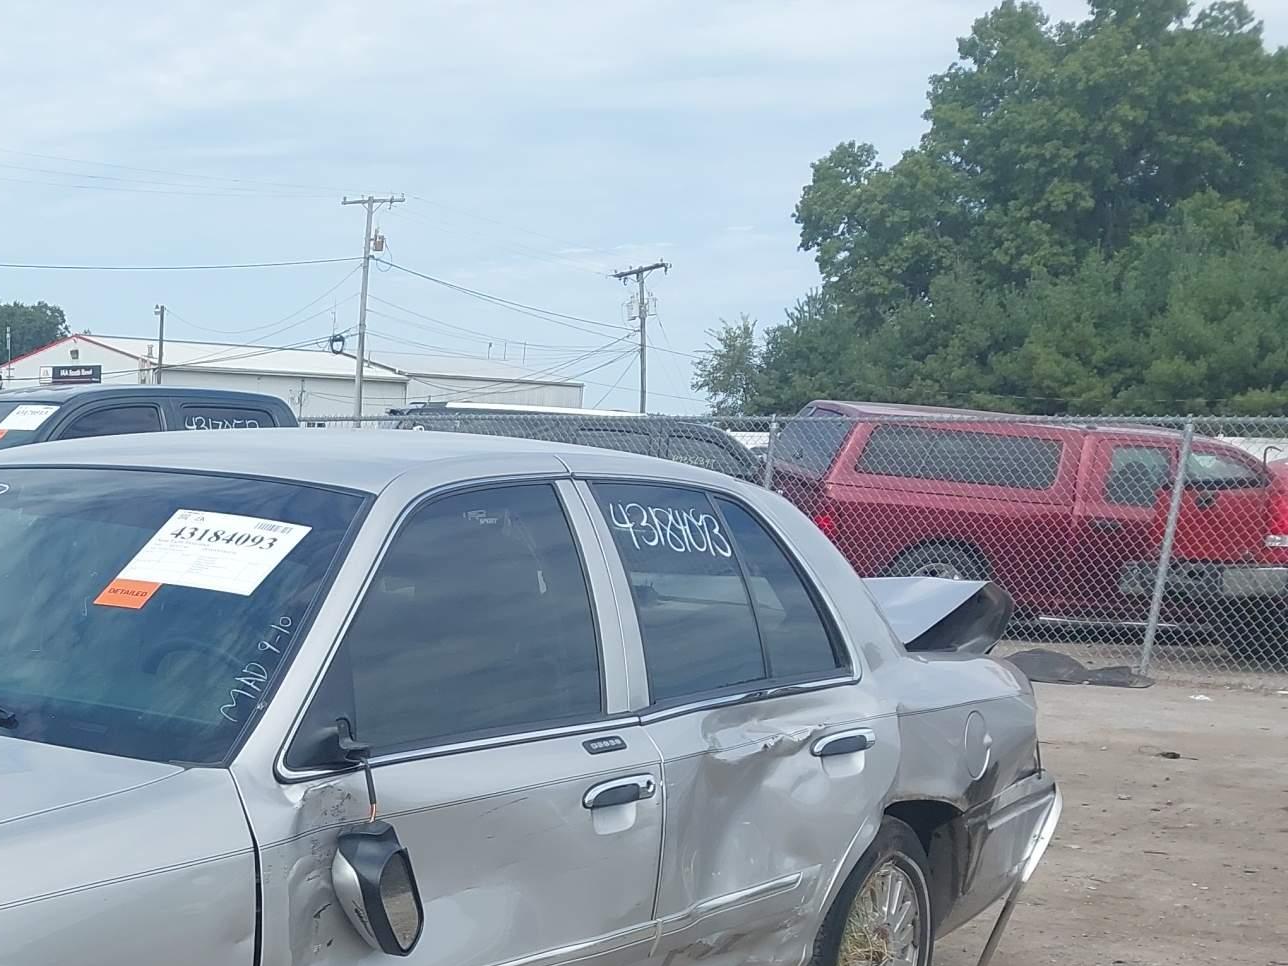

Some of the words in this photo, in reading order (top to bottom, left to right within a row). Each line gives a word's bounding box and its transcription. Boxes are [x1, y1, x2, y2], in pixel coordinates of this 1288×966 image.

[170, 526, 279, 550] 43184093
[107, 587, 148, 597] DETAILED
[220, 662, 268, 722] MAD
[257, 616, 292, 654] 9-10
